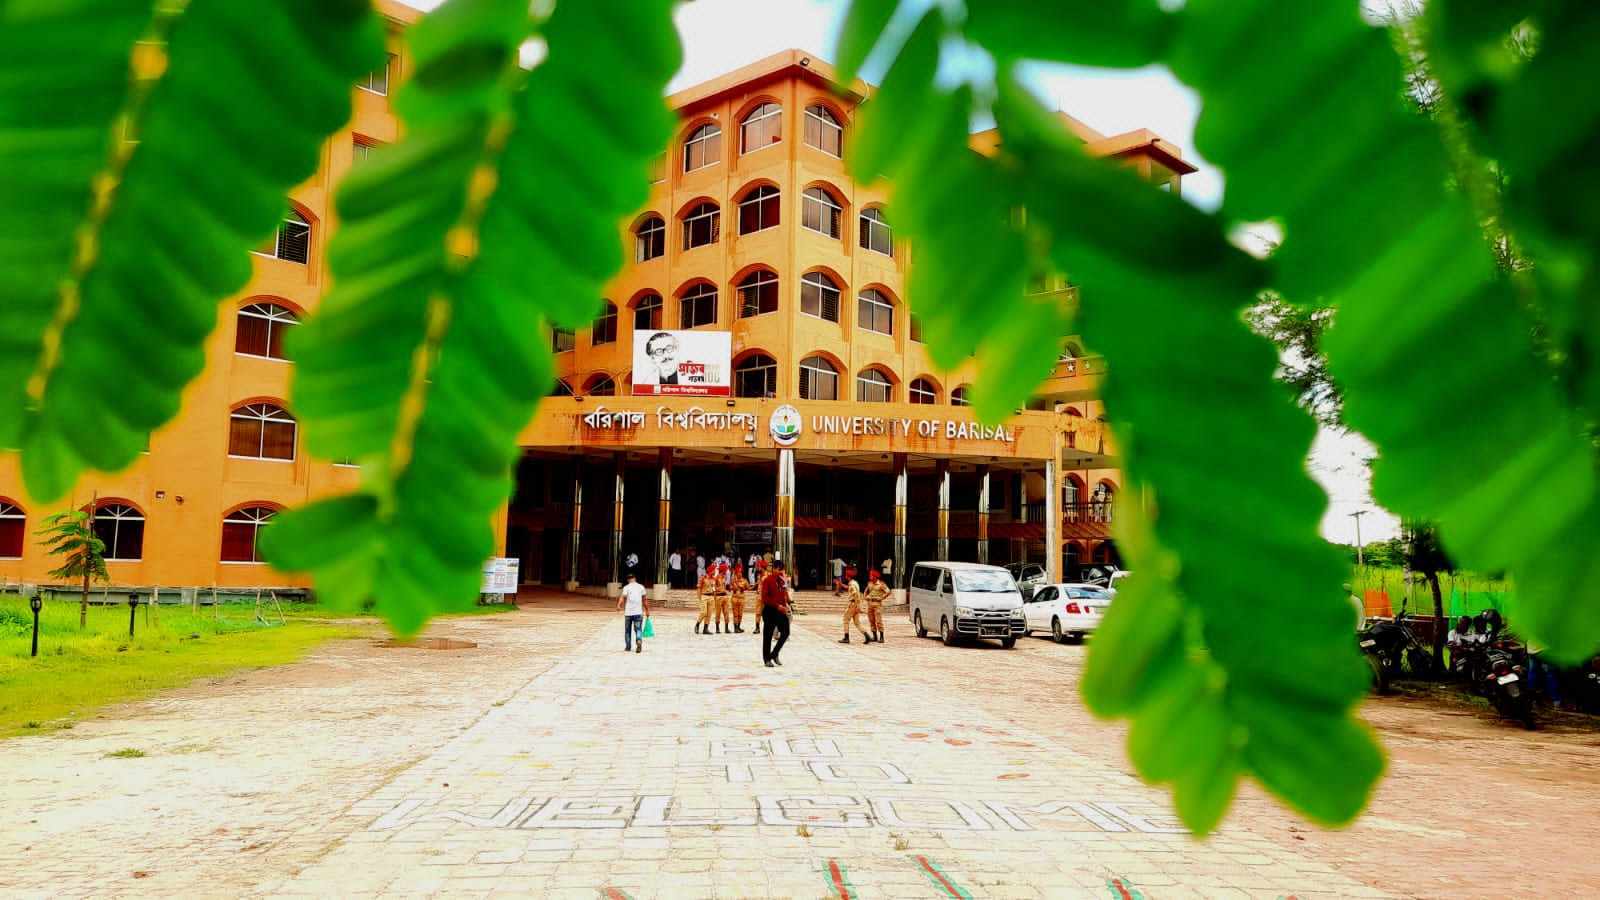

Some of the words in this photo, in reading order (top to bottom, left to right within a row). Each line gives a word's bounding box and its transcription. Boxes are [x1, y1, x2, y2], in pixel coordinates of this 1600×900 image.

[583, 405, 645, 430] বরিশাল
[656, 405, 758, 432] বিশ্ববিদ্যালয়
[812, 415, 911, 437] UNIVERSTY
[918, 419, 940, 438] OF
[946, 419, 1015, 442] BARISAL
[706, 760, 911, 784] TO
[367, 795, 1194, 834] WELCOME
